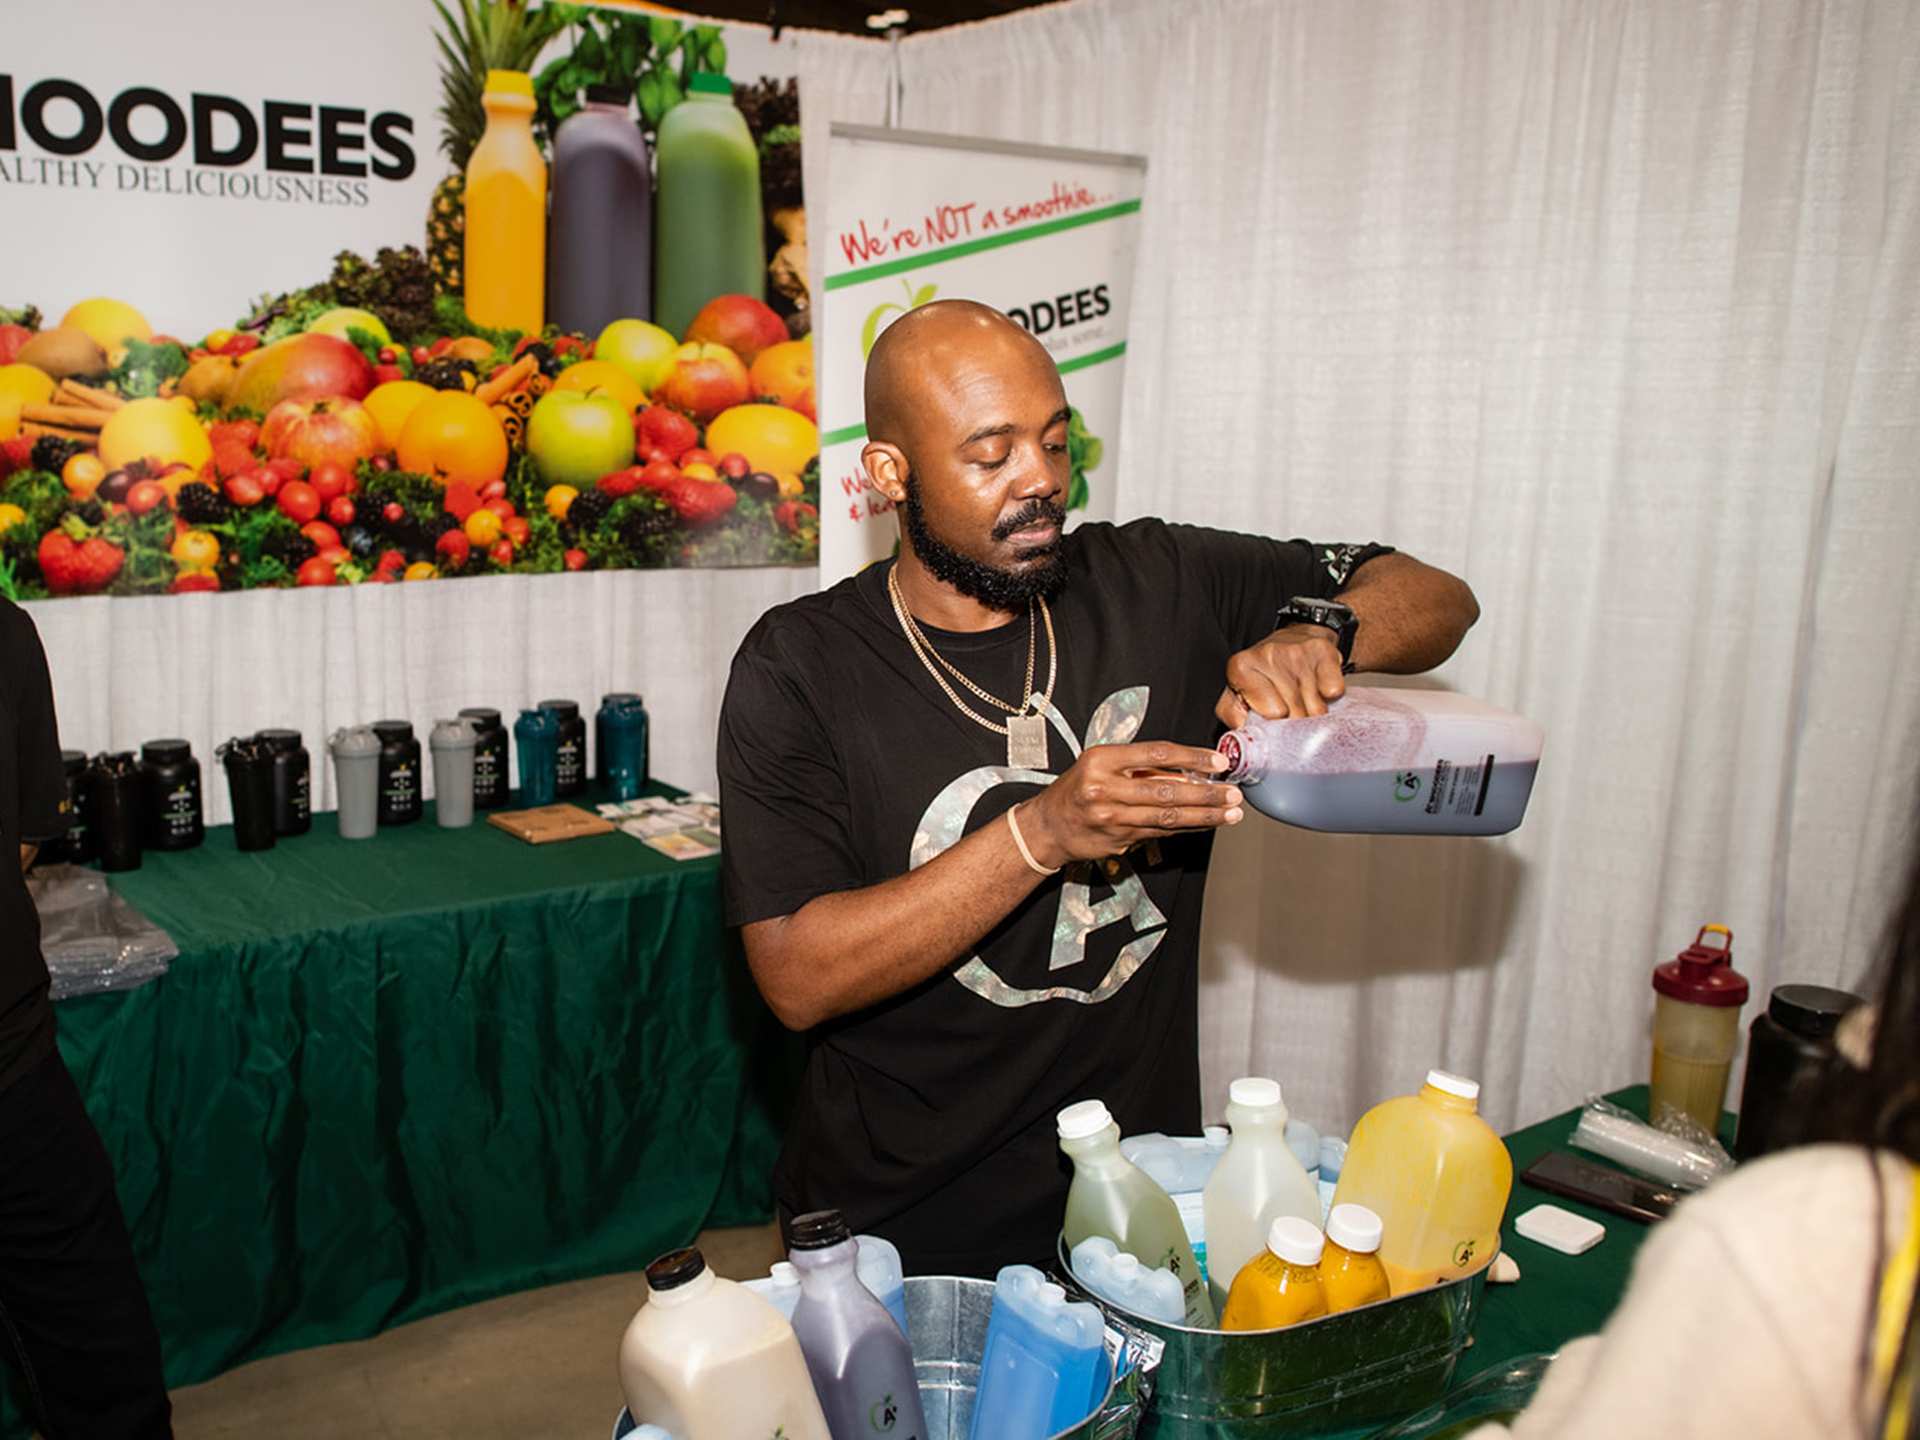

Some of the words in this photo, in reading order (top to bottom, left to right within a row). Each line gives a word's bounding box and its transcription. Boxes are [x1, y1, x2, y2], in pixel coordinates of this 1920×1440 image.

[0, 73, 416, 182] OODEES
[117, 164, 369, 208] DELICIOUSNESS
[839, 217, 922, 265] We're
[924, 201, 977, 244] NOT
[981, 209, 999, 229] a
